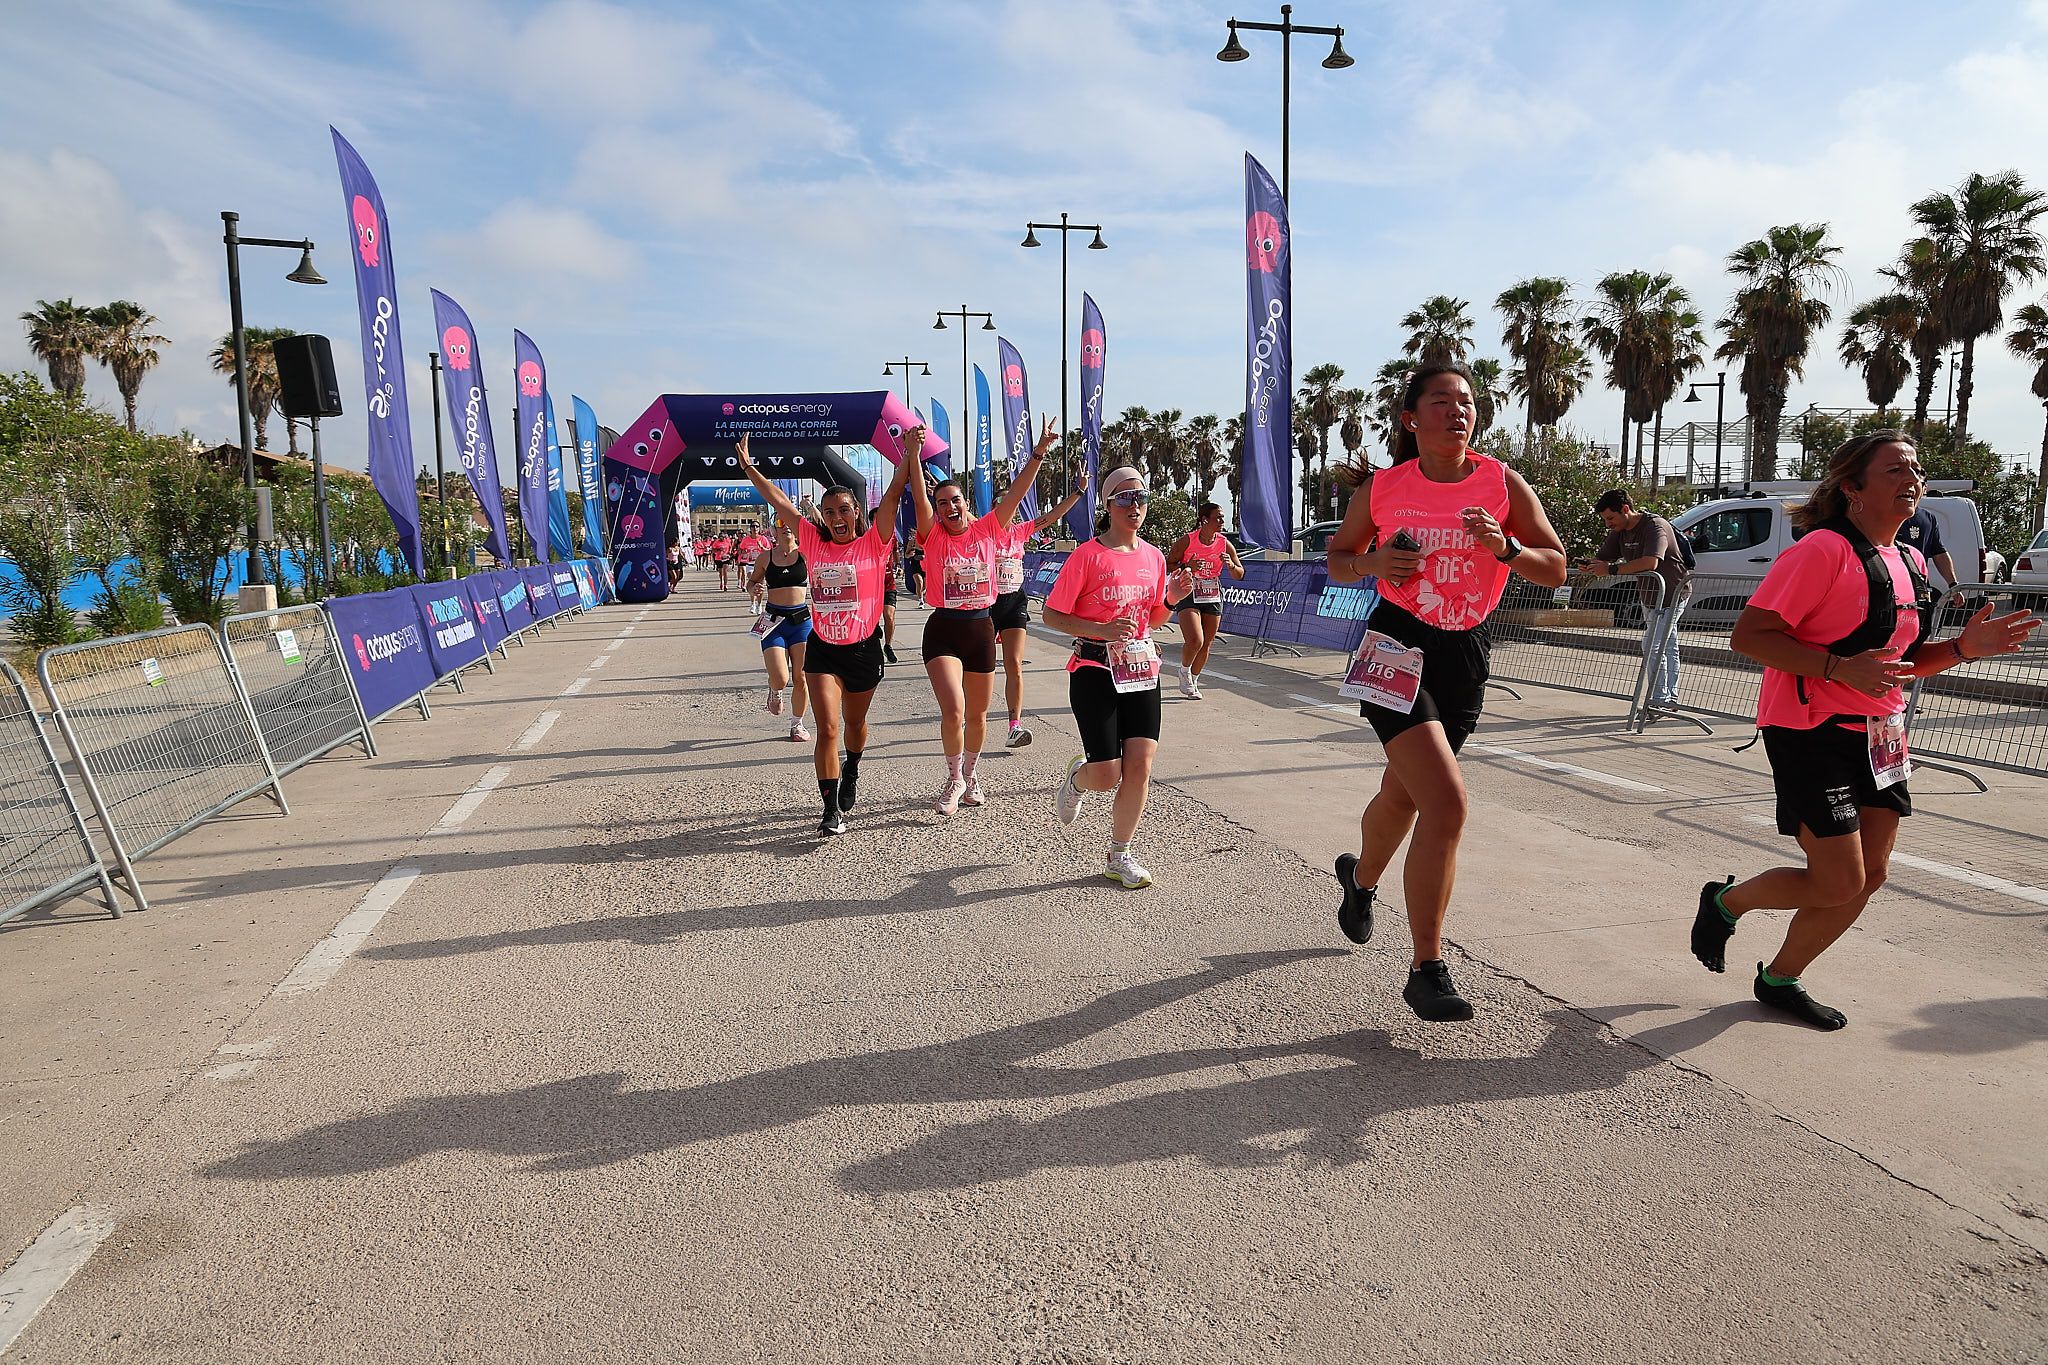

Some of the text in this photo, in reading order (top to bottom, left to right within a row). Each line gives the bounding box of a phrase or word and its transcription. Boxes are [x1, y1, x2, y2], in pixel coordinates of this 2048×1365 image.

[739, 403, 833, 417] octopus energy
[715, 420, 838, 429] LA ENERGÍA PARA CORRER
[701, 456, 805, 466] VOLVO
[1394, 509, 1428, 517] OYSHO
[823, 587, 842, 595] 016
[959, 583, 977, 591] 016
[1129, 661, 1150, 672] 016
[1367, 662, 1396, 680] 016
[1377, 695, 1402, 708] Santander
[1889, 739, 1903, 753] 01
